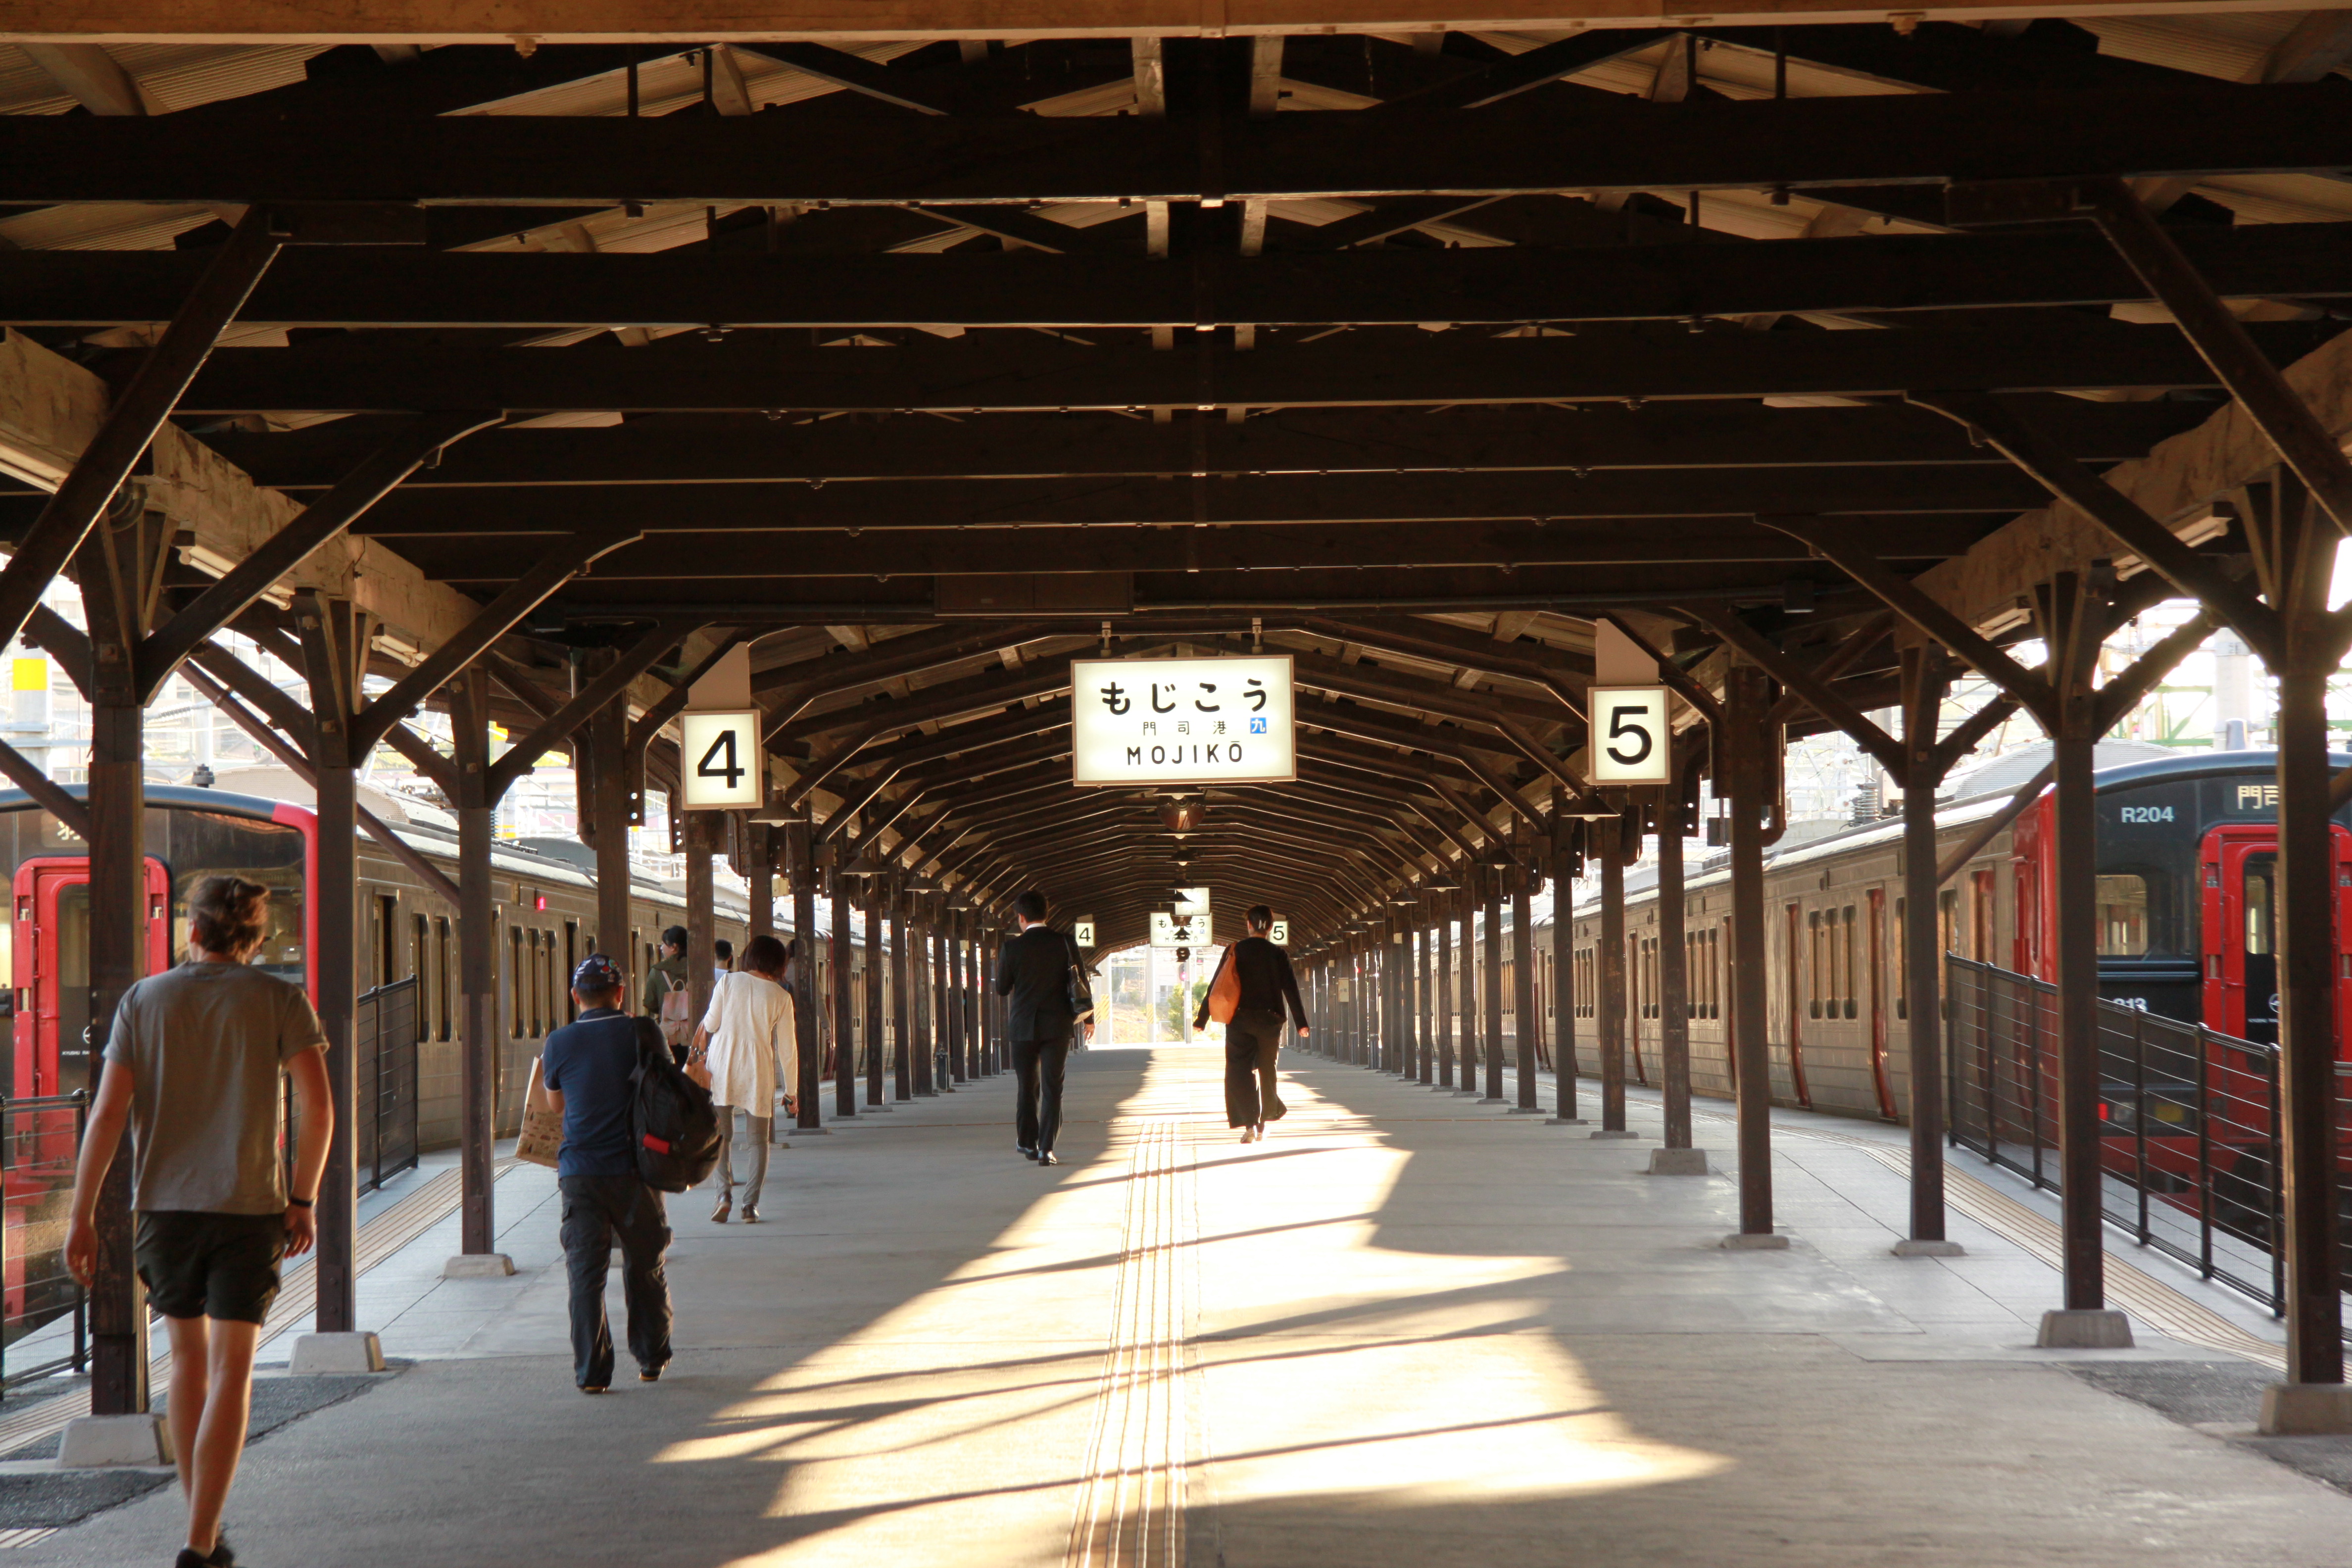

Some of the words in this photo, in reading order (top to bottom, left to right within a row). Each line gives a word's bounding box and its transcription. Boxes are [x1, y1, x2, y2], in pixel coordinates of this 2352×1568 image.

[1101, 679, 1267, 715] もじこう
[1143, 720, 1226, 735] 門司港
[1607, 706, 1652, 765] 5
[697, 730, 745, 788] 4
[1127, 741, 1242, 765] MOJIKŌ
[2121, 806, 2174, 823] R204
[1079, 927, 1091, 942] 4
[1273, 926, 1284, 940] 5
